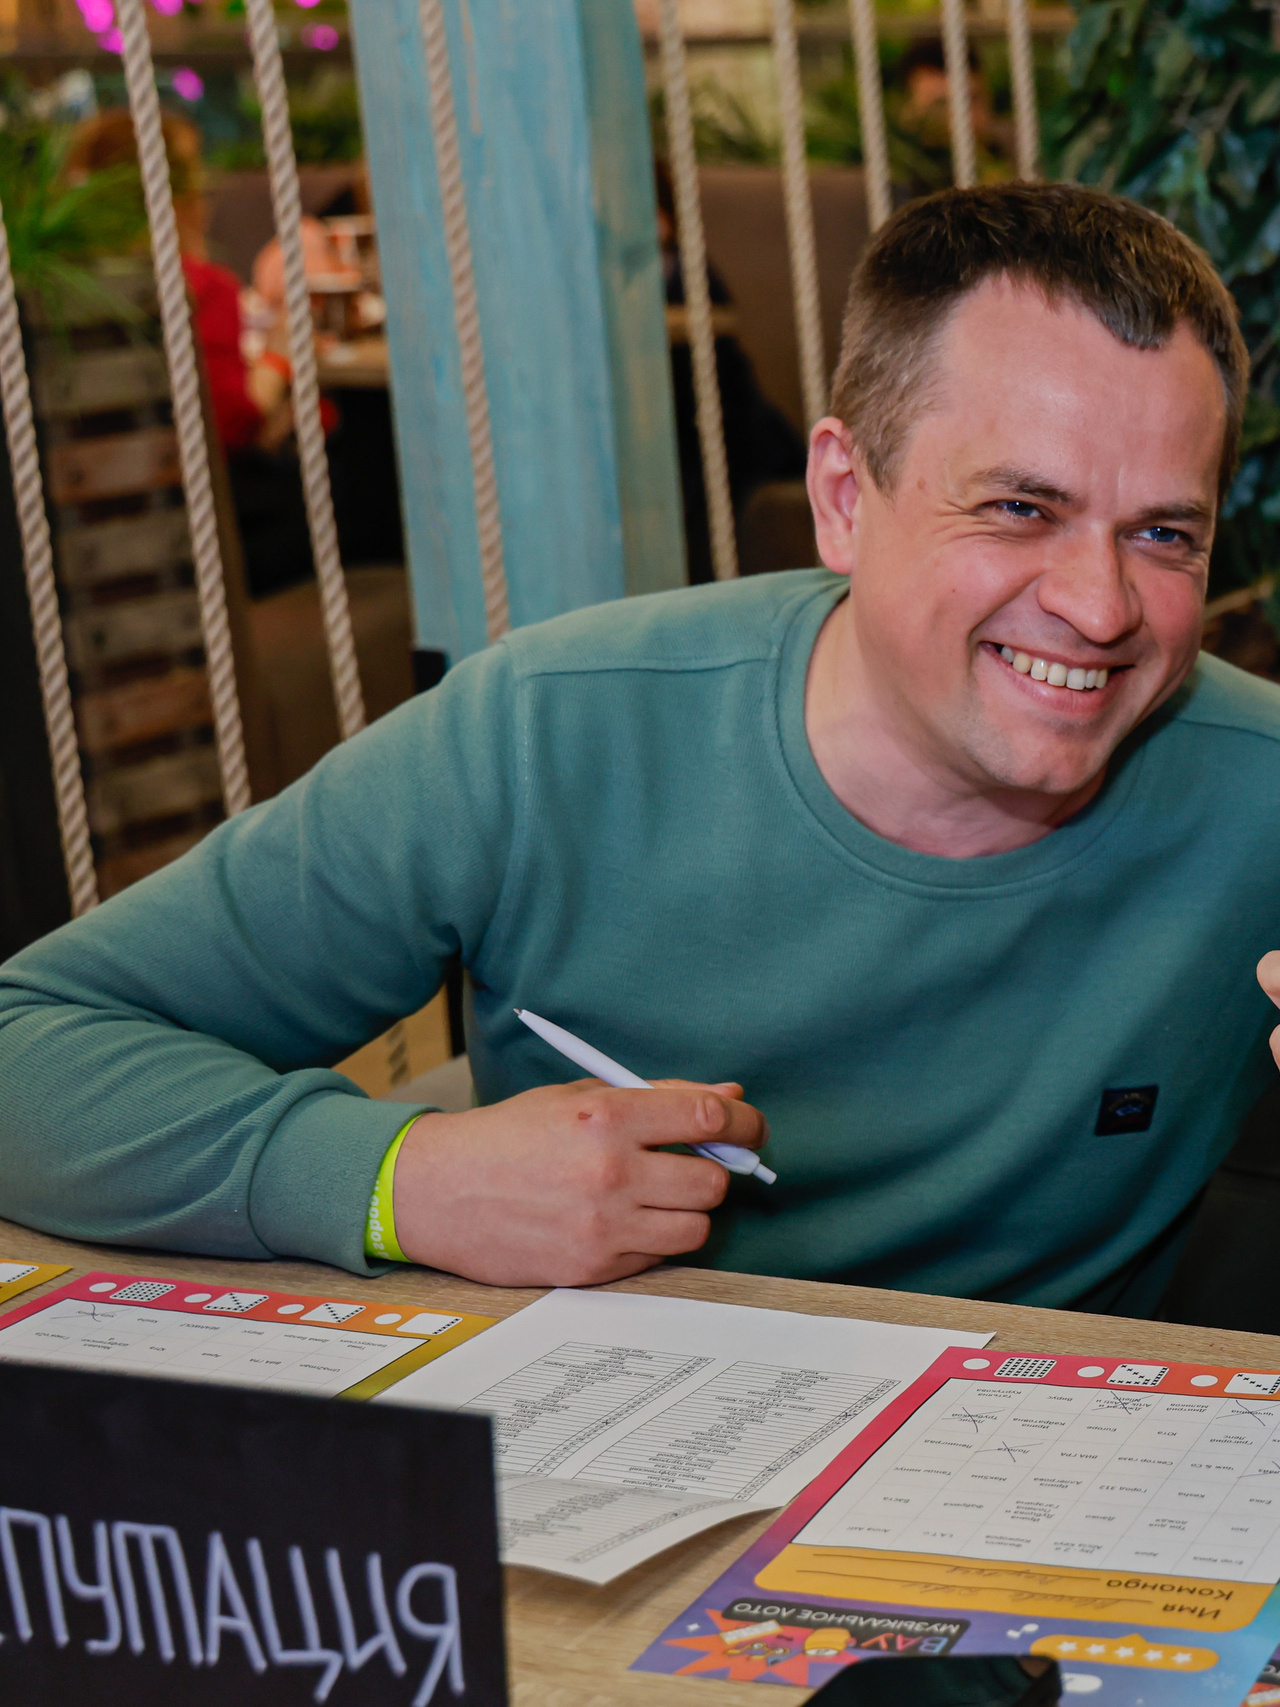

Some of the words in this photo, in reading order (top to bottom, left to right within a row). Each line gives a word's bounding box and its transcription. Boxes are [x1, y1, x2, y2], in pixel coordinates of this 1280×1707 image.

[973, 1387, 1023, 1395] Куртукова
[1164, 1405, 1208, 1413] Дмитрий
[1167, 1401, 1210, 1409] Маликов
[1009, 1416, 1068, 1426] Кайратовна
[919, 1438, 976, 1449] Ленинград
[1207, 1437, 1254, 1445] Григорий
[1137, 1457, 1175, 1465] Сектор
[890, 1465, 922, 1473] минус
[920, 1468, 954, 1476] Танцы
[1211, 1464, 1235, 1472] Чиж
[1030, 1476, 1084, 1485] Аллегрова
[1037, 1481, 1069, 1489] Ирина
[1116, 1485, 1148, 1493] Город
[879, 1495, 911, 1503] Баста
[939, 1501, 985, 1510] Фабрика
[1013, 1499, 1061, 1508] Гагарина
[1013, 1504, 1053, 1512] Полина
[1011, 1509, 1056, 1518] Дубцова
[1082, 1513, 1117, 1521] Данко
[1007, 1514, 1041, 1522] Ирина
[1152, 1517, 1188, 1525] дождя
[982, 1533, 1033, 1543] Киркоров
[1074, 1542, 1104, 1550] Alicia
[1190, 1554, 1220, 1563] Крид
[1107, 1579, 1234, 1602] Команда
[0, 1506, 465, 1707] ПУТАЦИЯ
[731, 1602, 797, 1617] ЛОТО
[1162, 1603, 1222, 1620] Имя
[799, 1608, 960, 1635] МУЗЫКАЛЬНОЕ
[859, 1632, 949, 1654] ВАУ
